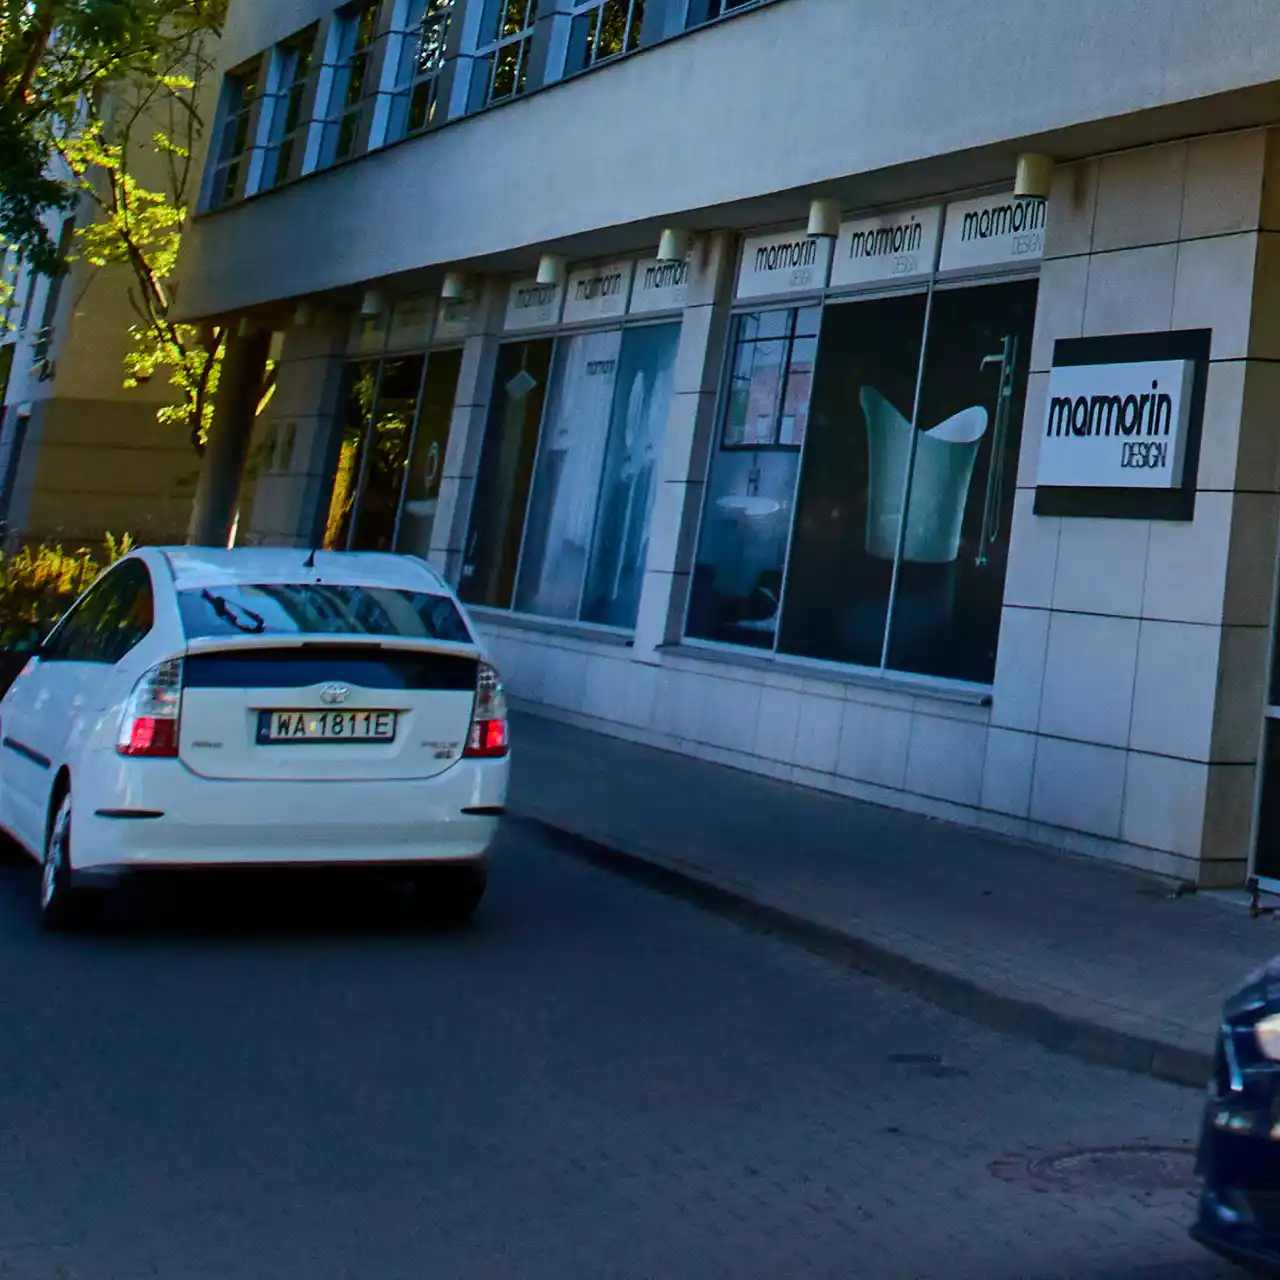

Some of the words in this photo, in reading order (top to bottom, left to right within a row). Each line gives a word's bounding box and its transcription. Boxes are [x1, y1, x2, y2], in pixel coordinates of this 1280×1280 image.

[850, 215, 922, 258] marmorin
[962, 200, 1046, 242] marmorin
[754, 238, 817, 273] marmorin
[1046, 380, 1172, 437] marmorin
[1121, 442, 1167, 468] DESIGN
[277, 712, 306, 737] WA
[318, 711, 391, 737] 1811E
